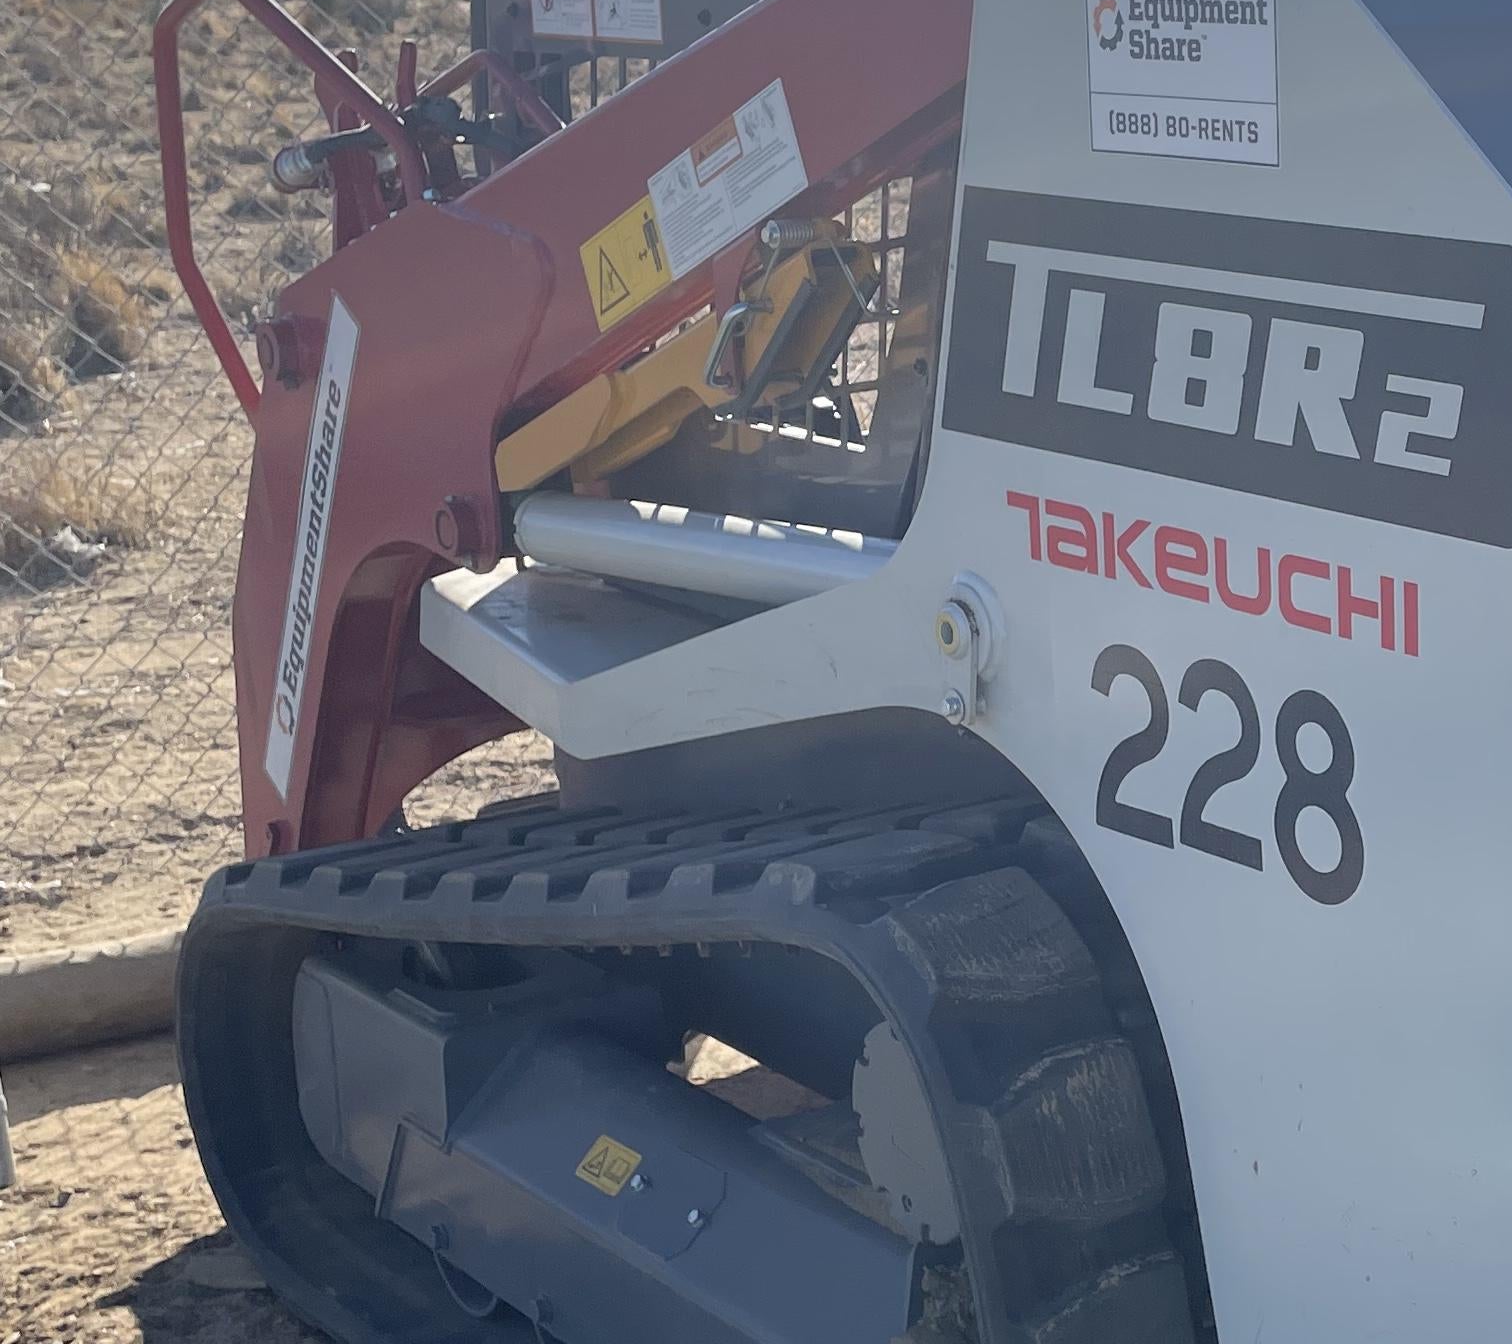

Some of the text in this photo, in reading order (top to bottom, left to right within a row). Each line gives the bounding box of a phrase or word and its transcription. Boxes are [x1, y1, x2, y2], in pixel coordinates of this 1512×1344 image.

[1108, 109, 1259, 144] (888) 80-RENTS
[281, 379, 341, 698] EquipmentShare
[1090, 643, 1365, 905] 228
